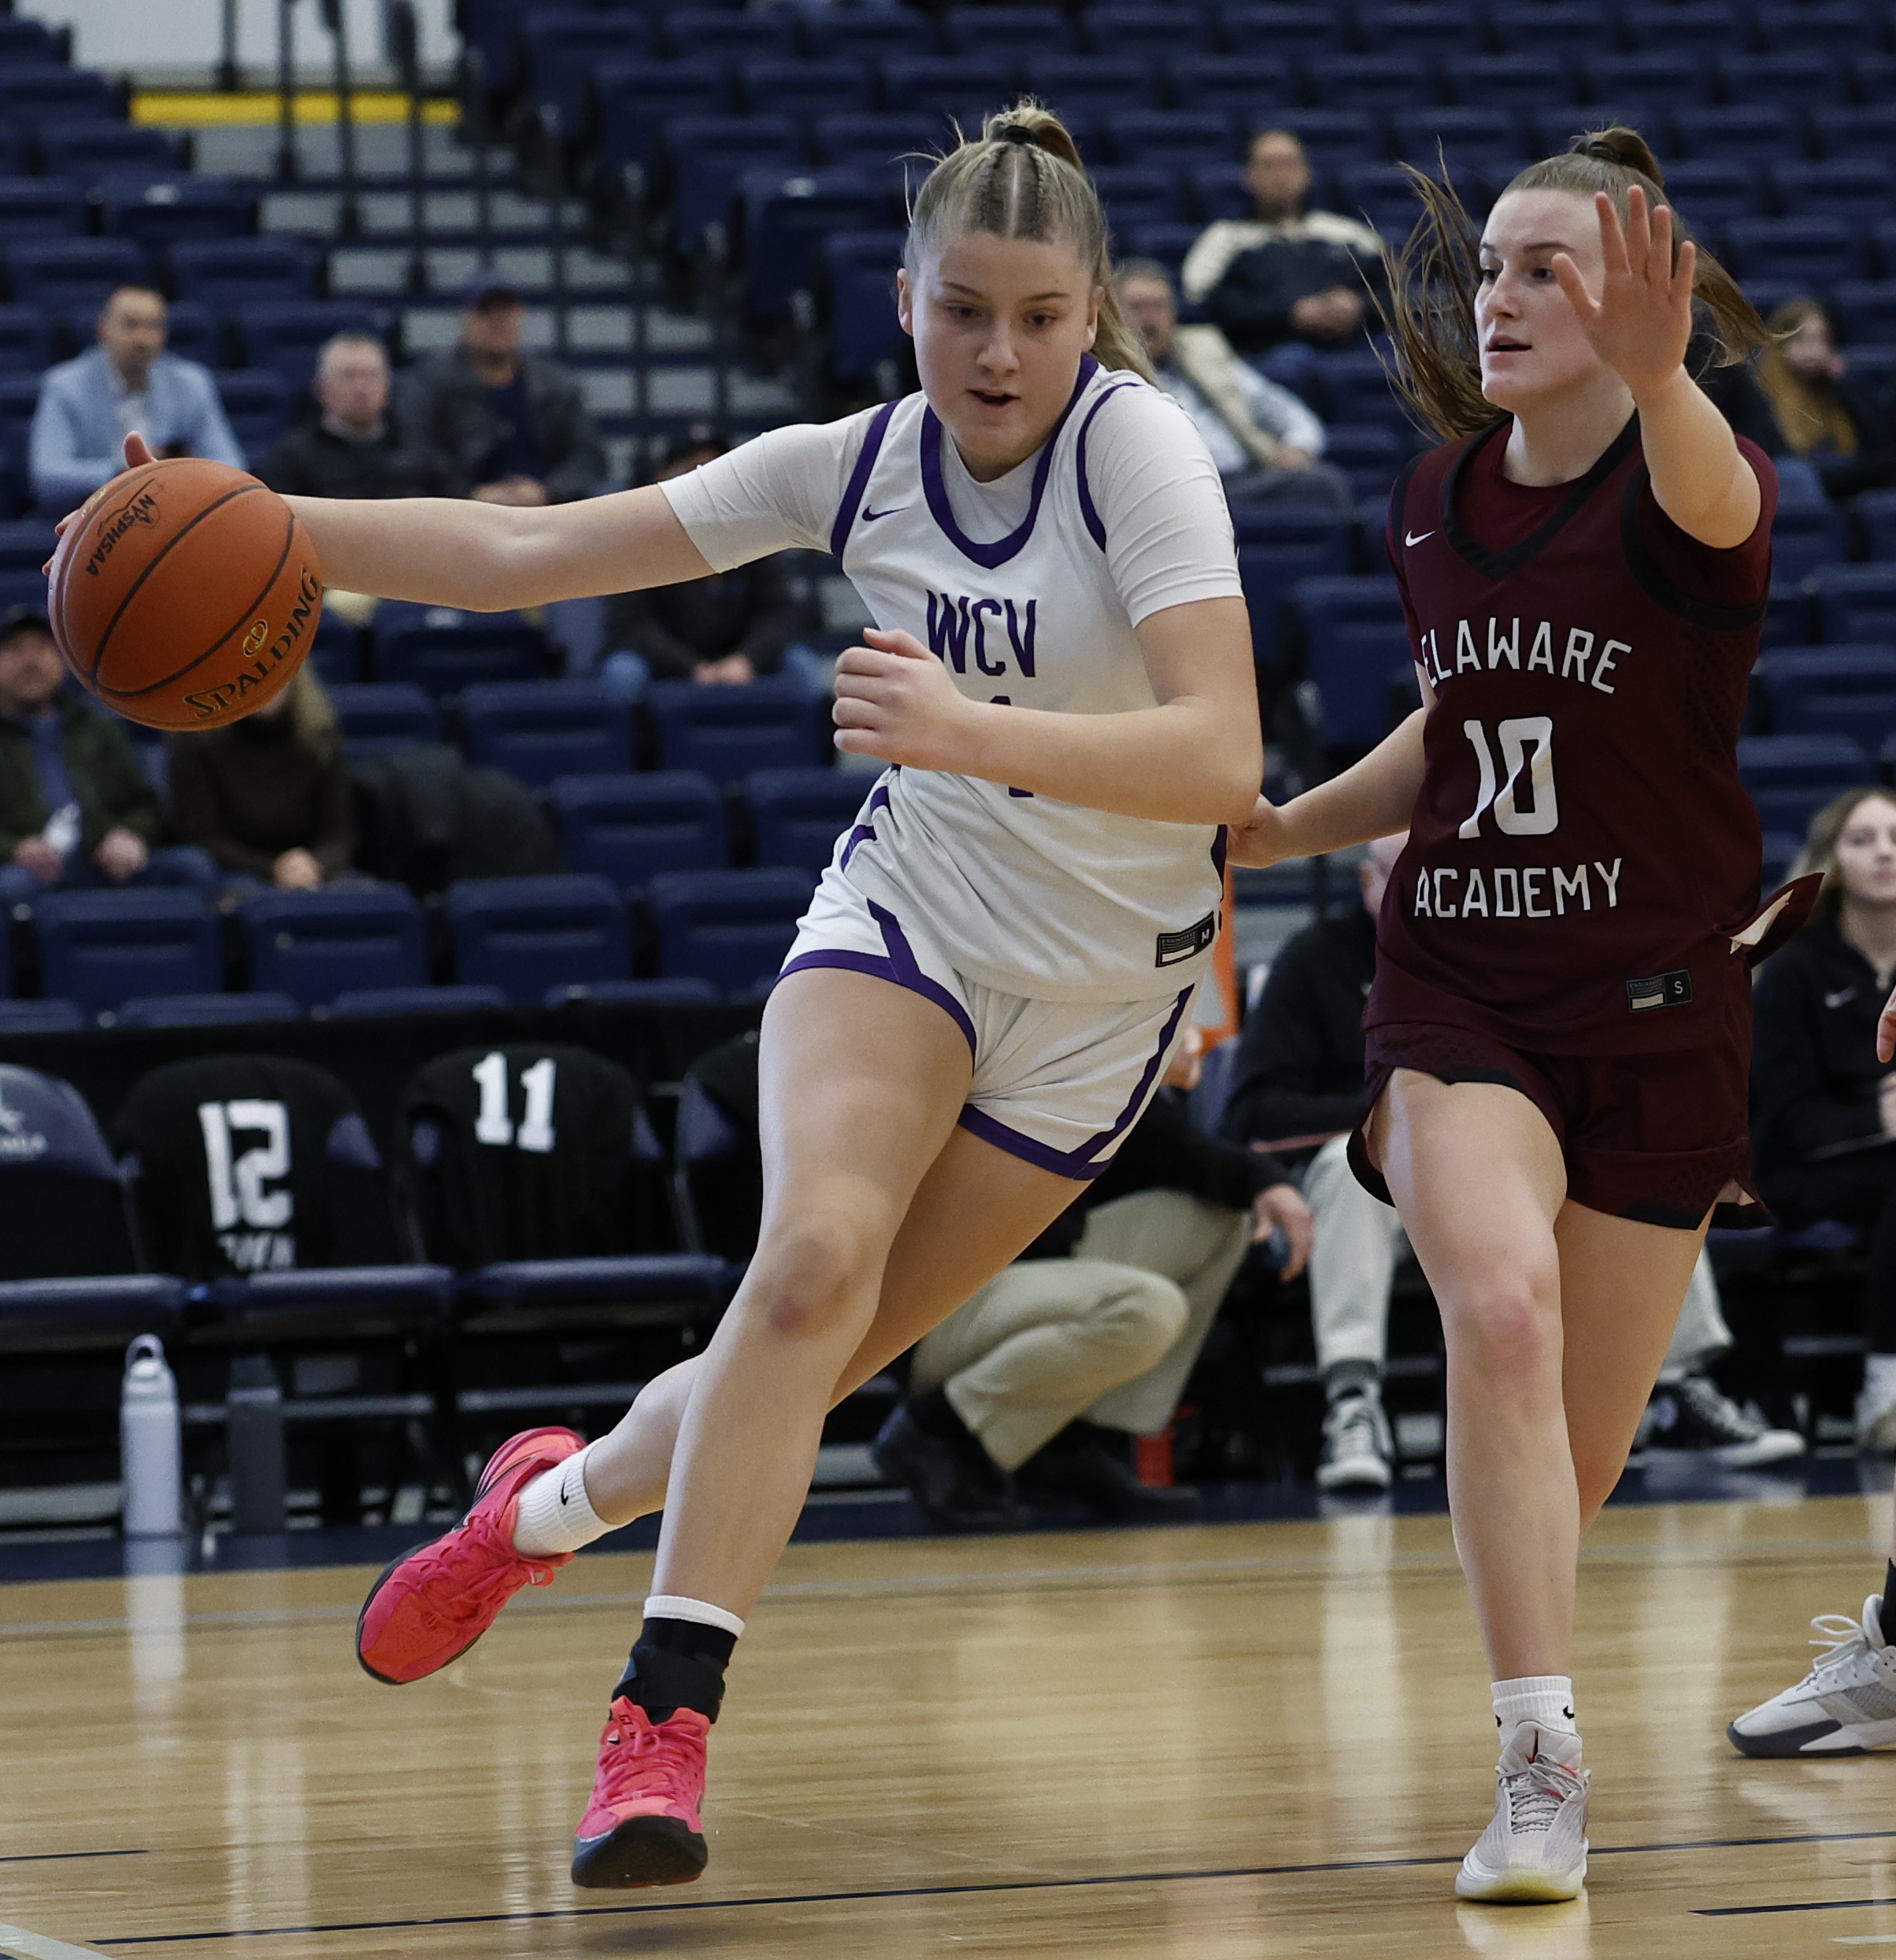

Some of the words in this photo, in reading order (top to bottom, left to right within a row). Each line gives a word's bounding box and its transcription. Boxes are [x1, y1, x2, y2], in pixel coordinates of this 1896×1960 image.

[86, 494, 156, 576] NYSPHSAA
[183, 565, 319, 718] SPALDING
[926, 589, 1037, 677] WCV
[1460, 717, 1558, 839] 10
[1415, 858, 1622, 917] ACADEMY
[1674, 980, 1683, 995] S
[472, 1051, 557, 1153] 11
